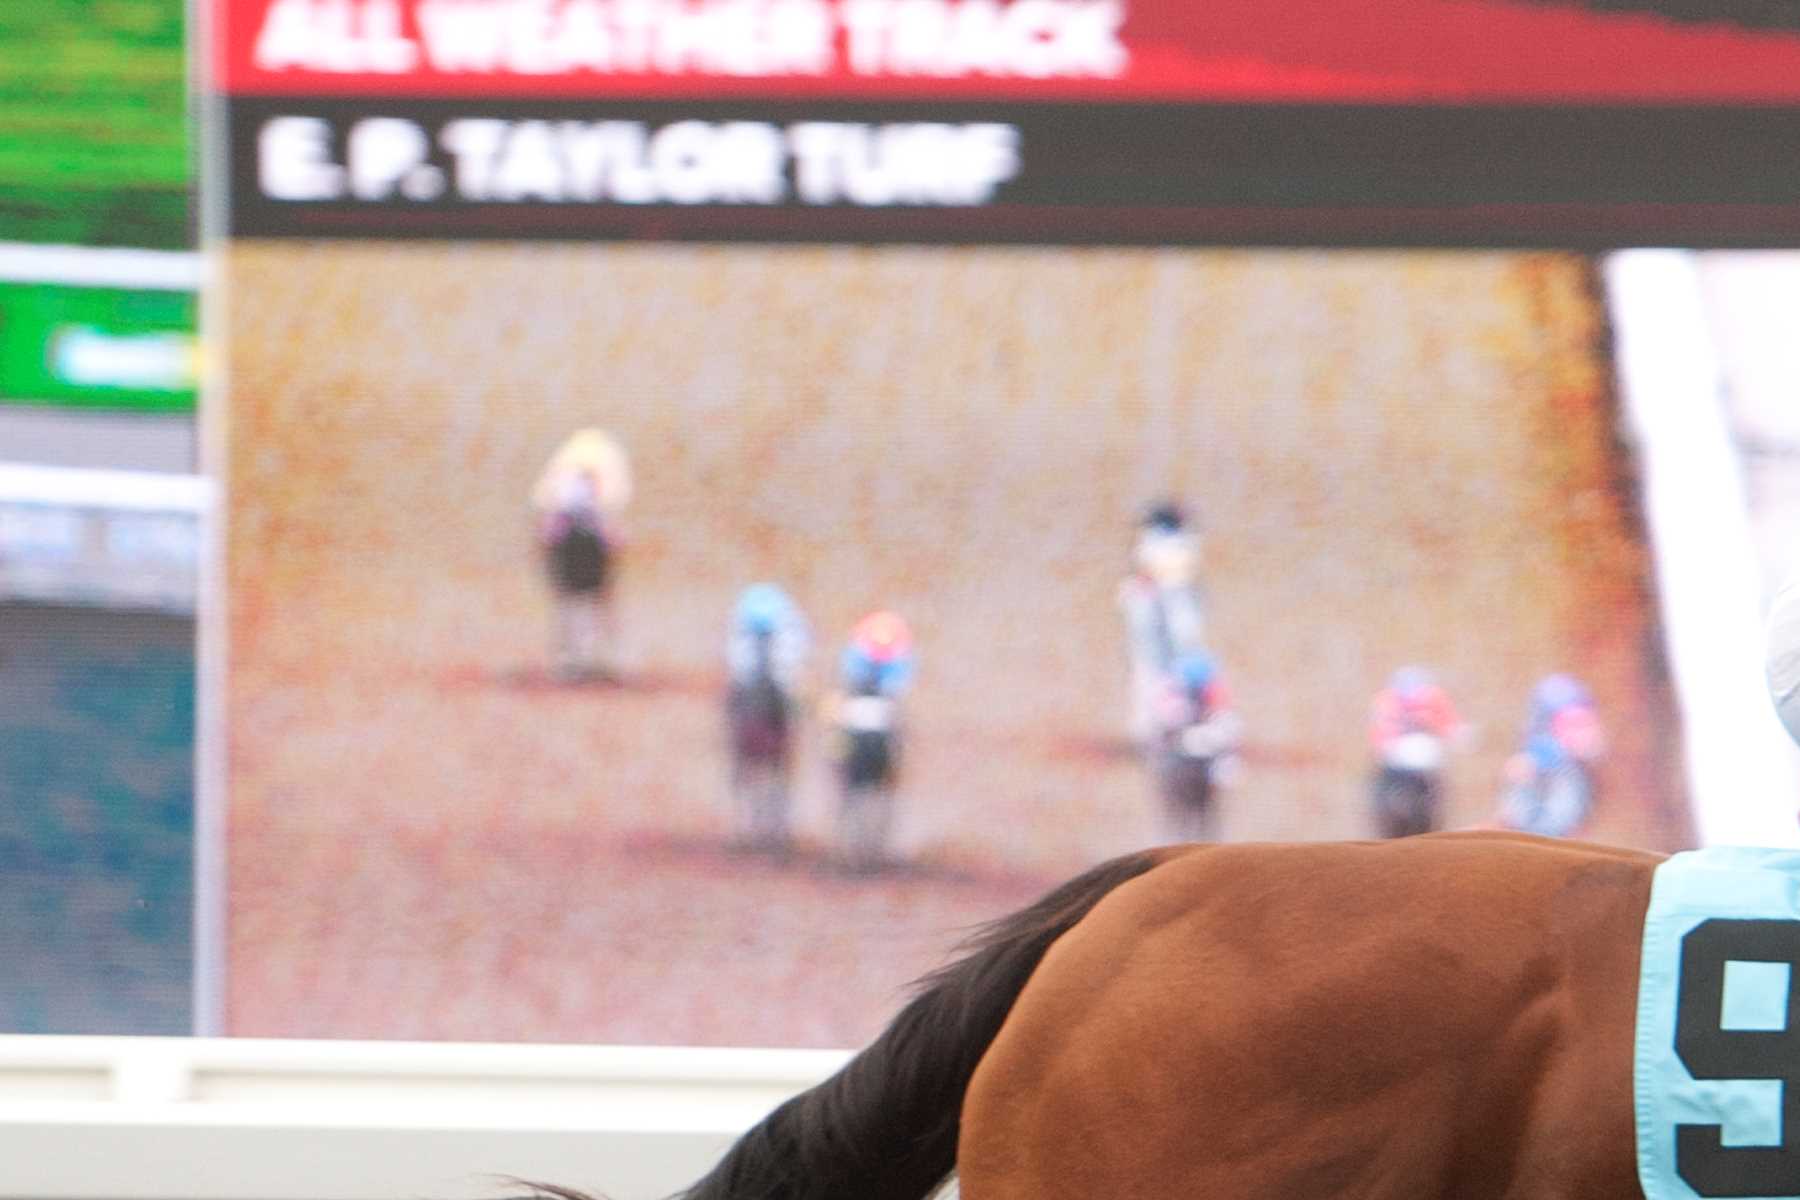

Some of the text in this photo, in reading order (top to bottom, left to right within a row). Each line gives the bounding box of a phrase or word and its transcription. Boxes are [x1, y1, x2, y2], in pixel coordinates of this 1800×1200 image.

[254, 0, 1130, 79] ALL WEATHER TRACK
[438, 118, 786, 204] TAYLOR
[786, 122, 1024, 206] TURF
